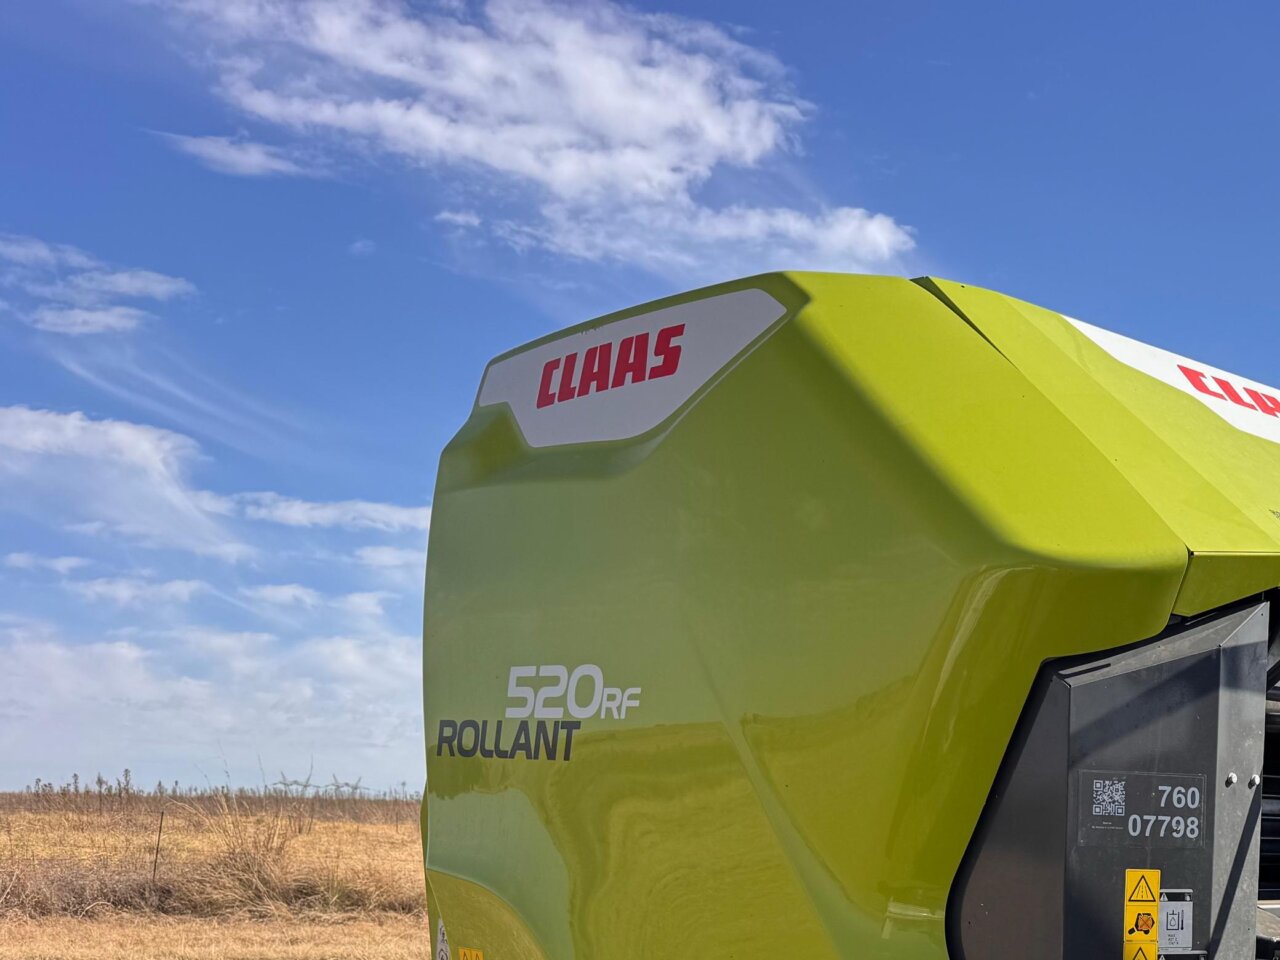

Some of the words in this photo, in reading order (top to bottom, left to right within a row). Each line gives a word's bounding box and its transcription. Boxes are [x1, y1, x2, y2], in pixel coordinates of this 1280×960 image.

[536, 323, 686, 409] CLAAS
[436, 719, 581, 761] ROLLANT
[1158, 785, 1200, 809] 760
[1128, 814, 1199, 838] 07798
